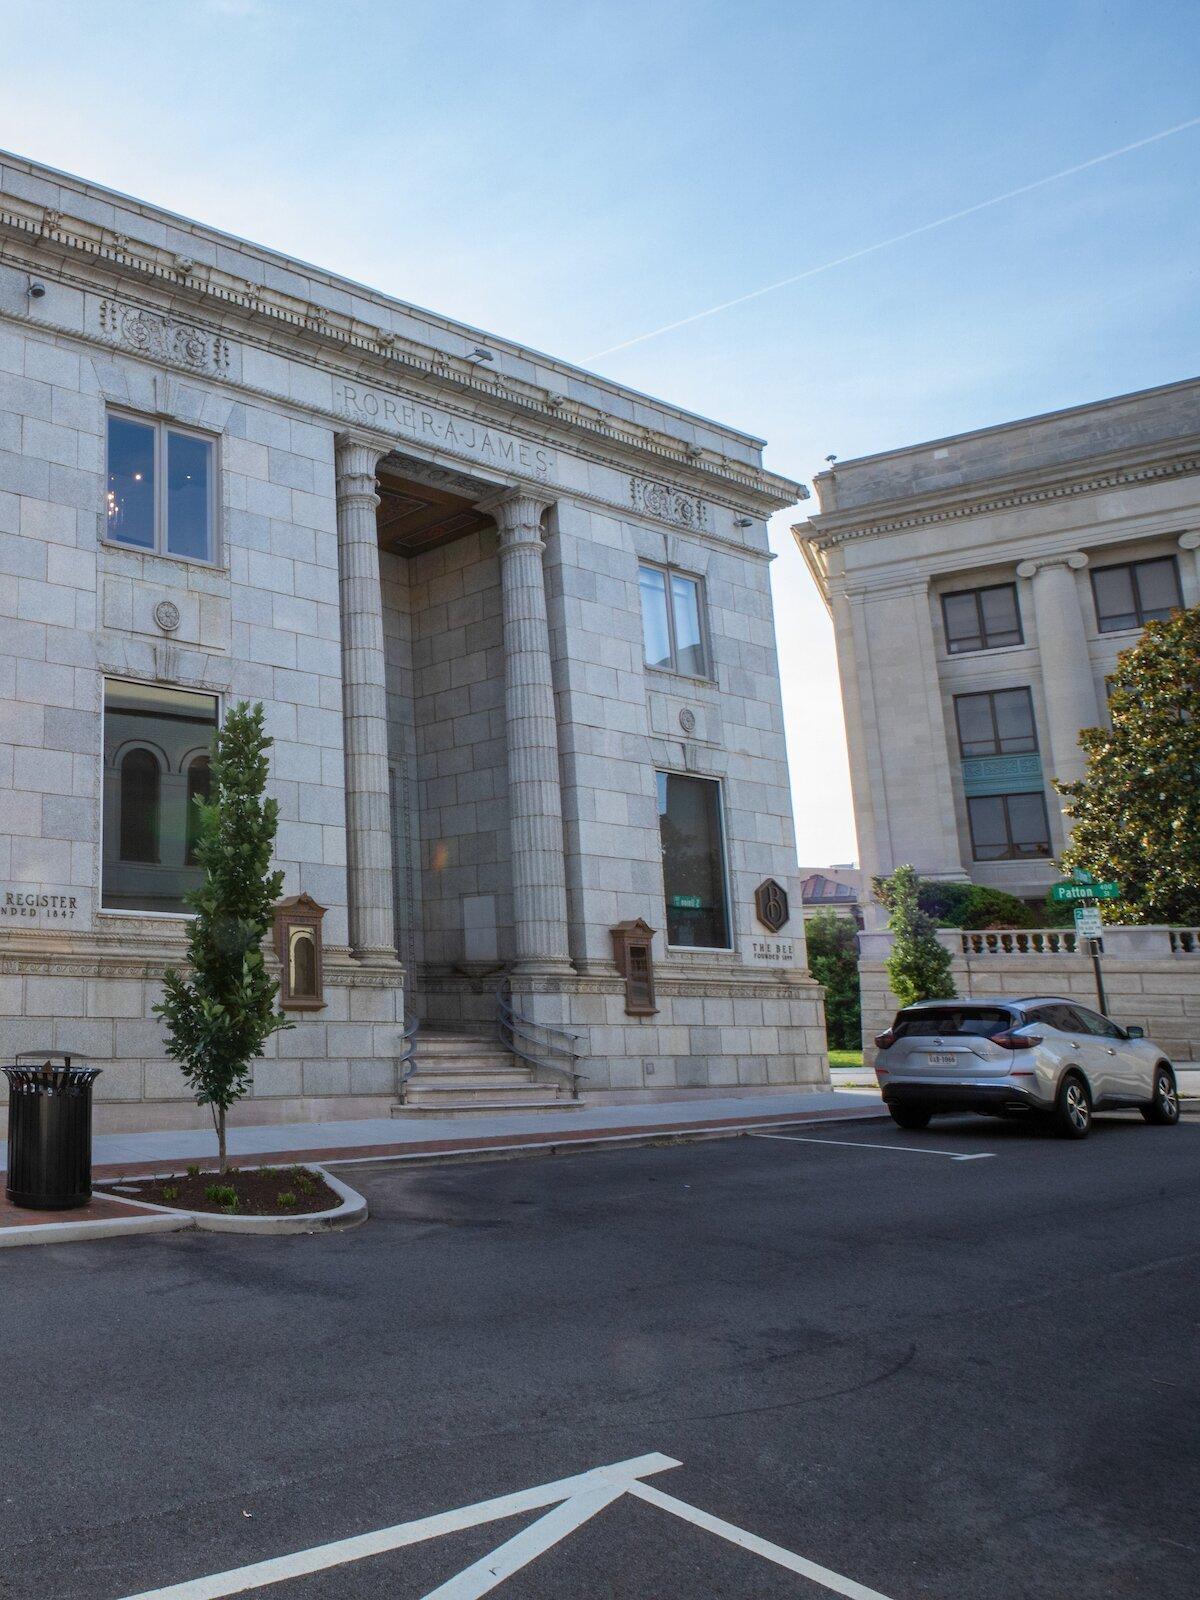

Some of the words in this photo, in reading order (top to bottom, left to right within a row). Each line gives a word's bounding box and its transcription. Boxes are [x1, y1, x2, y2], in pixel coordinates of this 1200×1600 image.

[1058, 887, 1093, 899] Patton
[6, 892, 78, 909] REGISTER
[47, 909, 75, 919] 1847
[752, 943, 771, 953] THE
[776, 944, 794, 954] BEE
